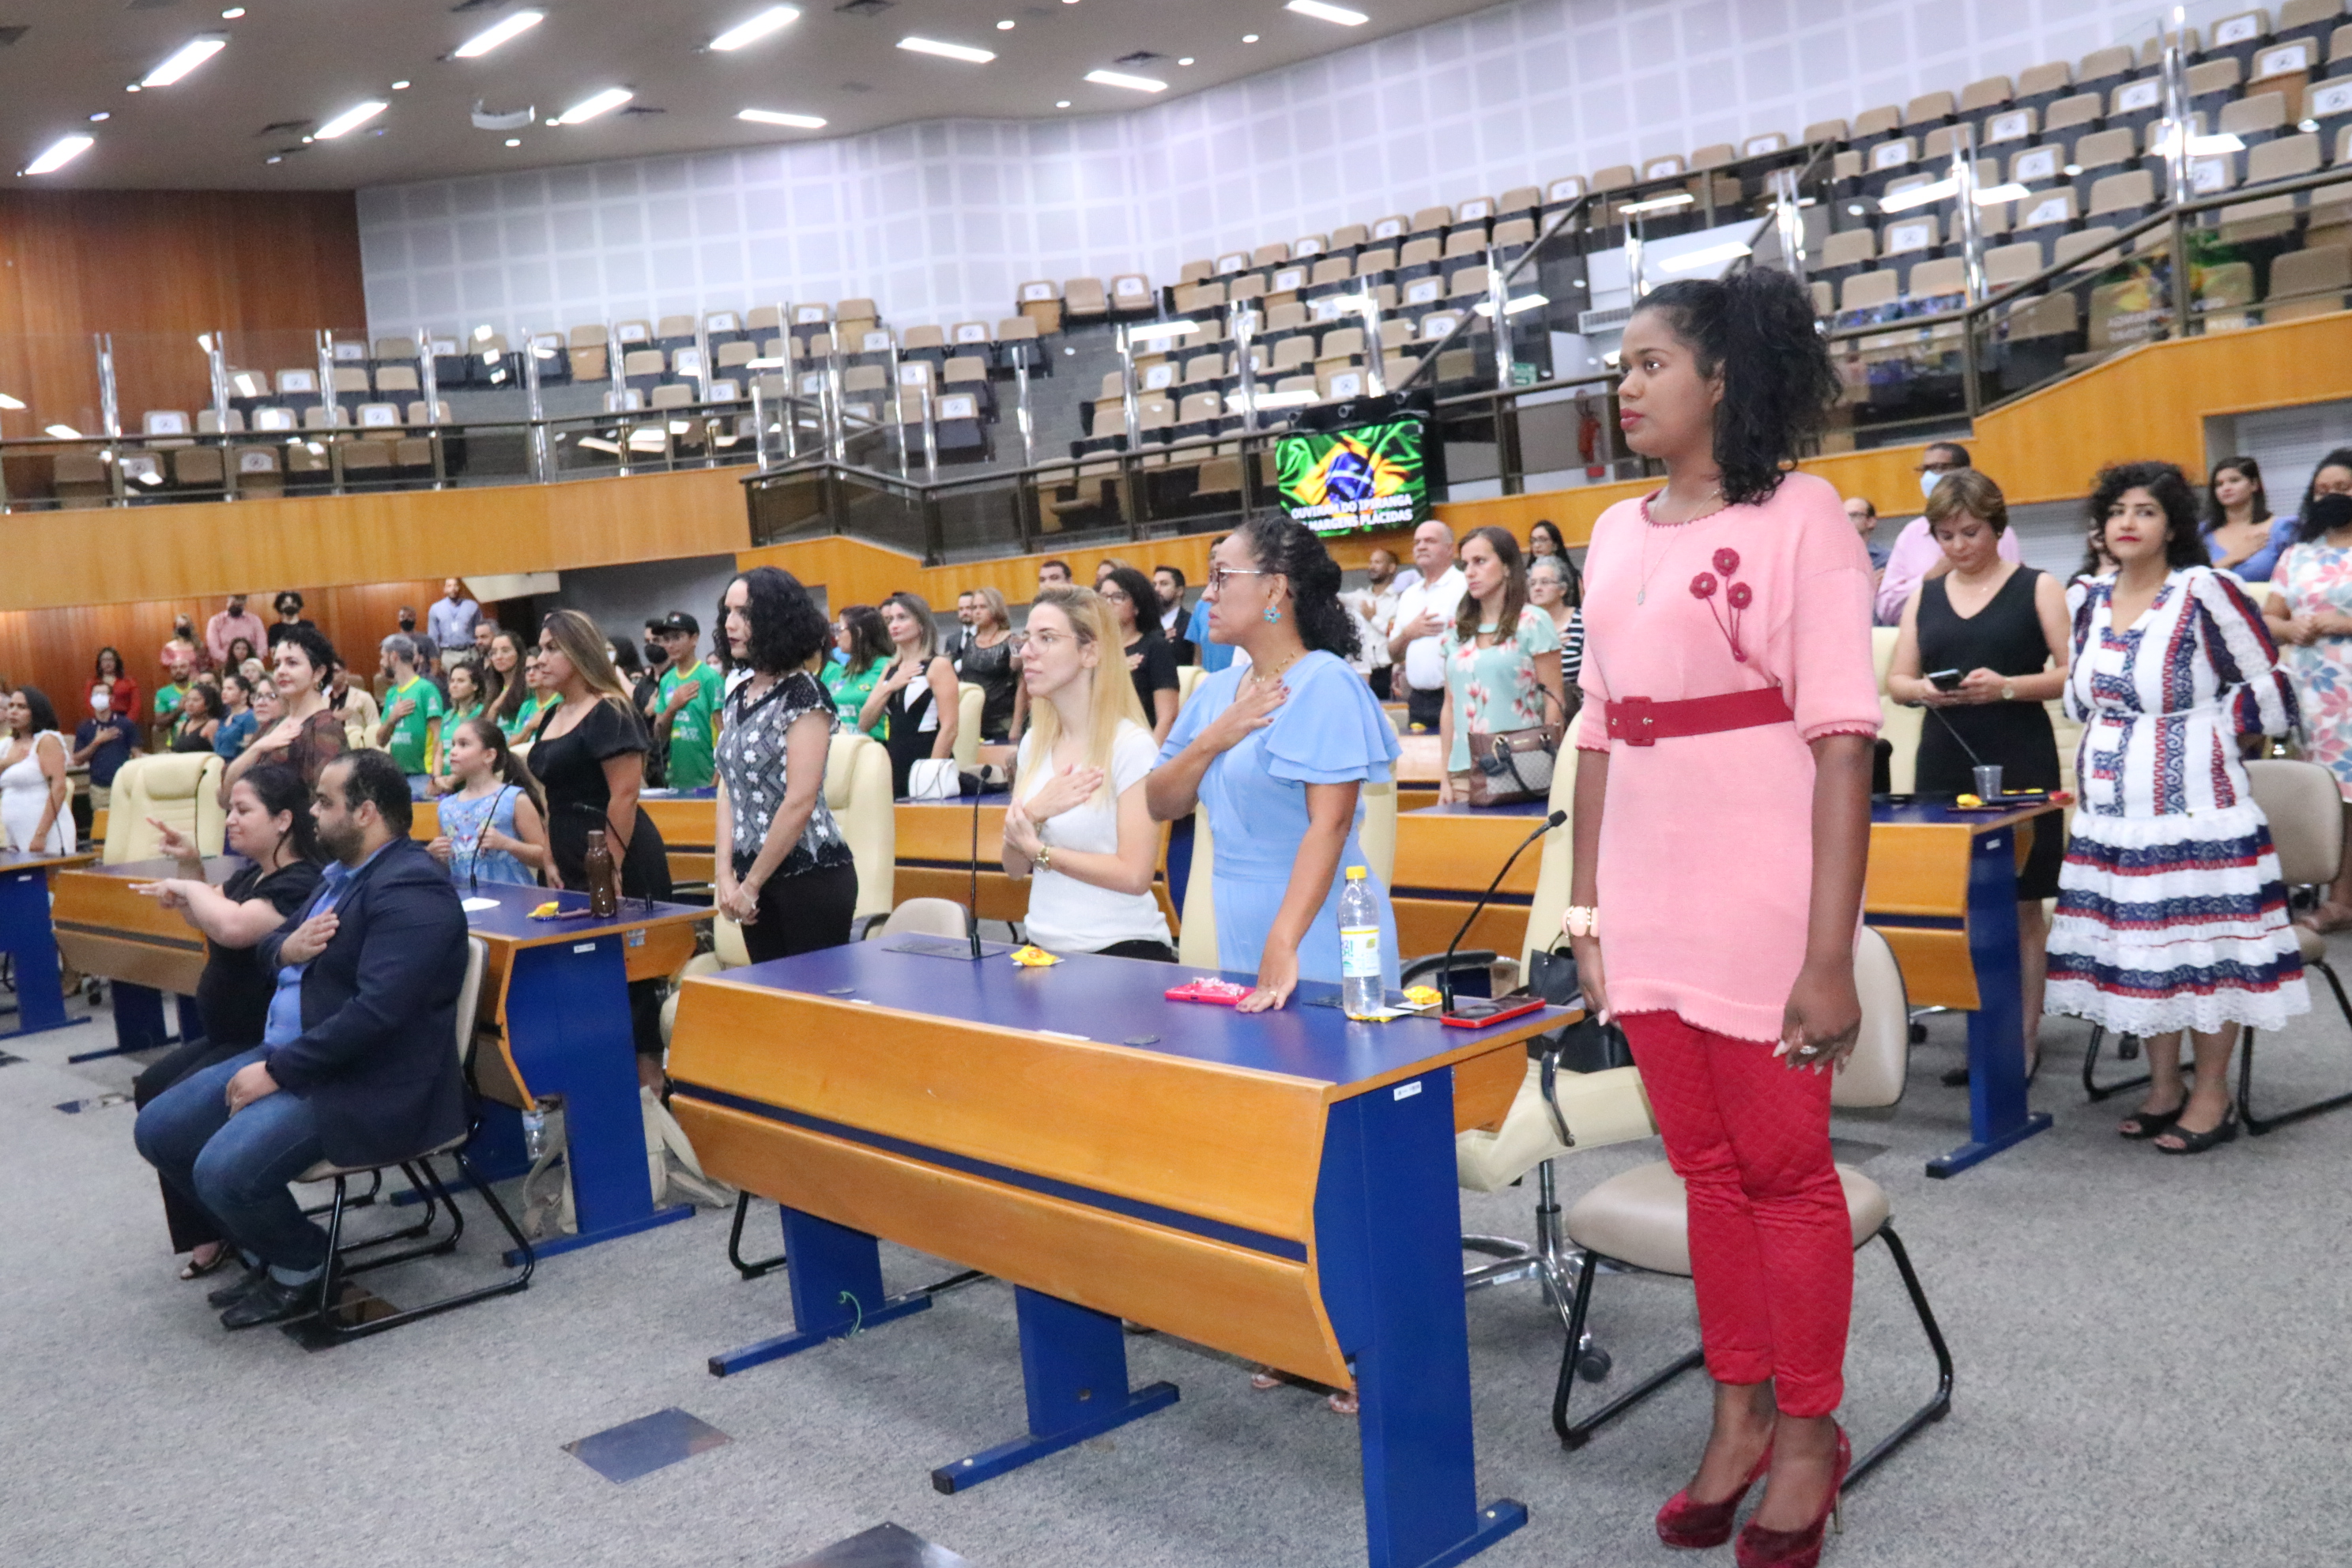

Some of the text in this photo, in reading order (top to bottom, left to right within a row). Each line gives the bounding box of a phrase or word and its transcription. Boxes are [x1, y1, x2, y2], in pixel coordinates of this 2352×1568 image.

[1291, 494, 1413, 519] OUVIRAM DO IPIRANGA
[1308, 508, 1413, 531] MARGENS PLÁCIDAS
